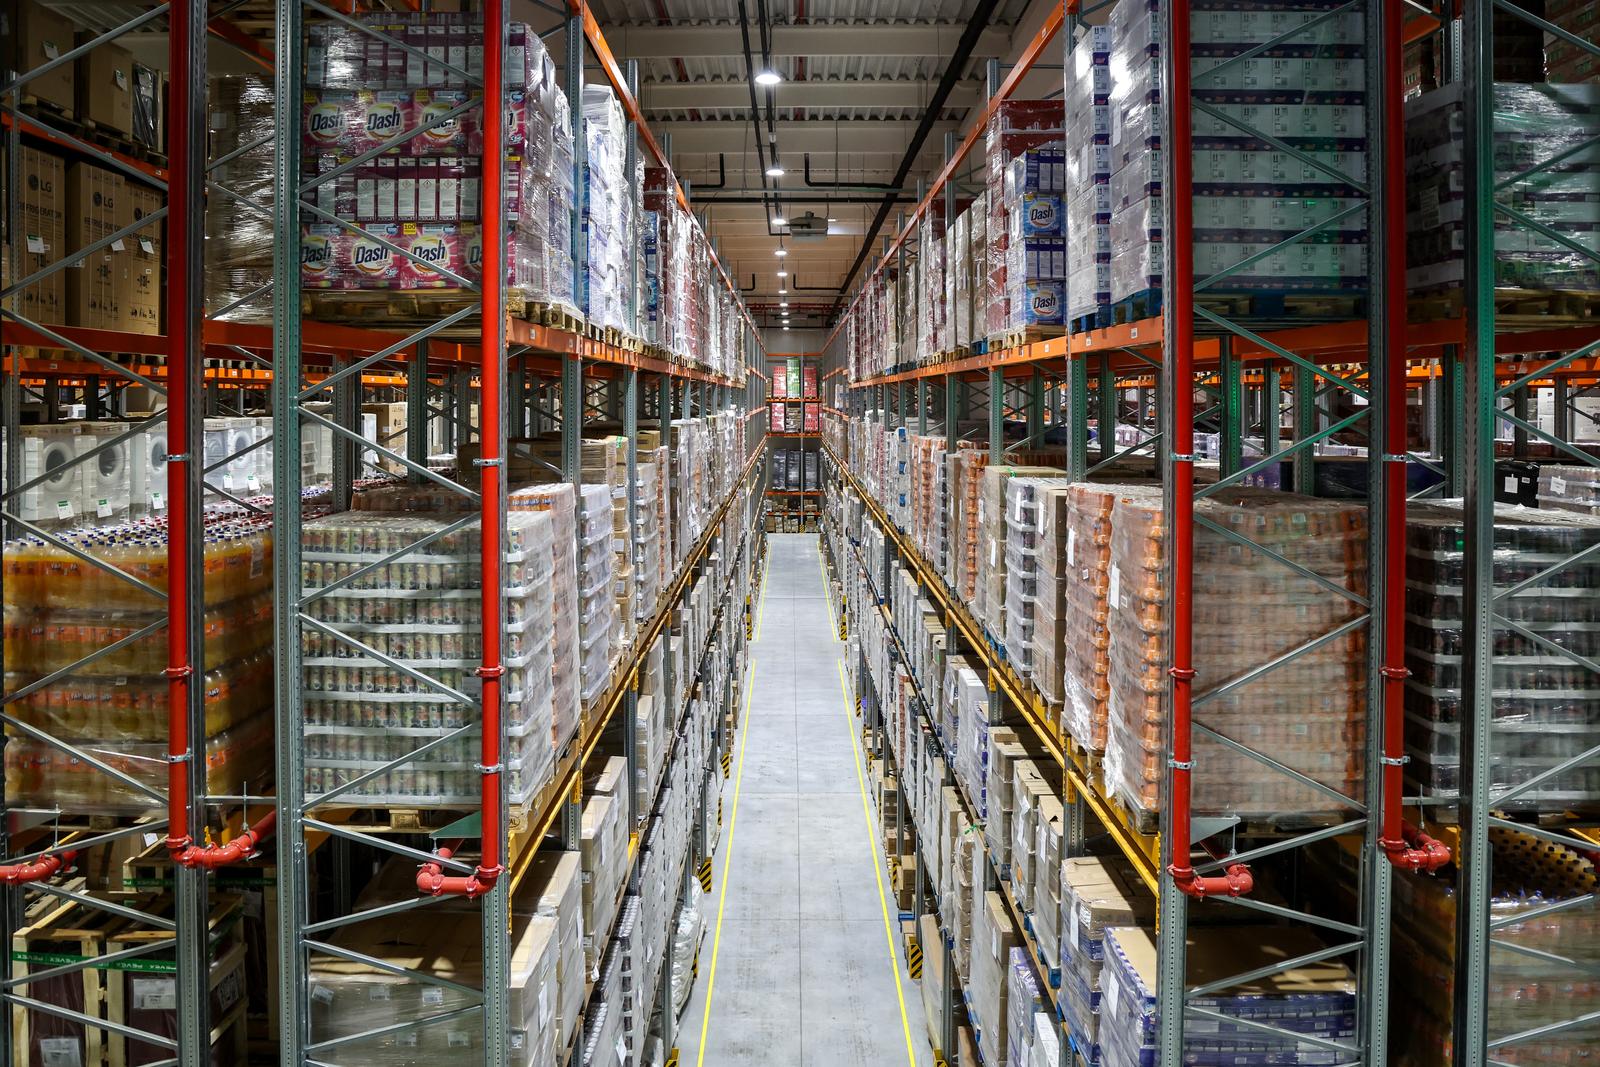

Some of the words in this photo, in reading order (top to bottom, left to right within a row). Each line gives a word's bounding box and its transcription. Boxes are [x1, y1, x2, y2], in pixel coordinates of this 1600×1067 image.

[311, 106, 343, 131] Dash
[367, 106, 400, 131] Dash
[40, 180, 52, 193] LG
[103, 197, 114, 209] LG
[1031, 204, 1054, 222] Dash
[302, 239, 332, 264] Dash
[355, 242, 388, 265] Dash
[412, 239, 445, 265] Dash
[1033, 294, 1056, 310] Dash
